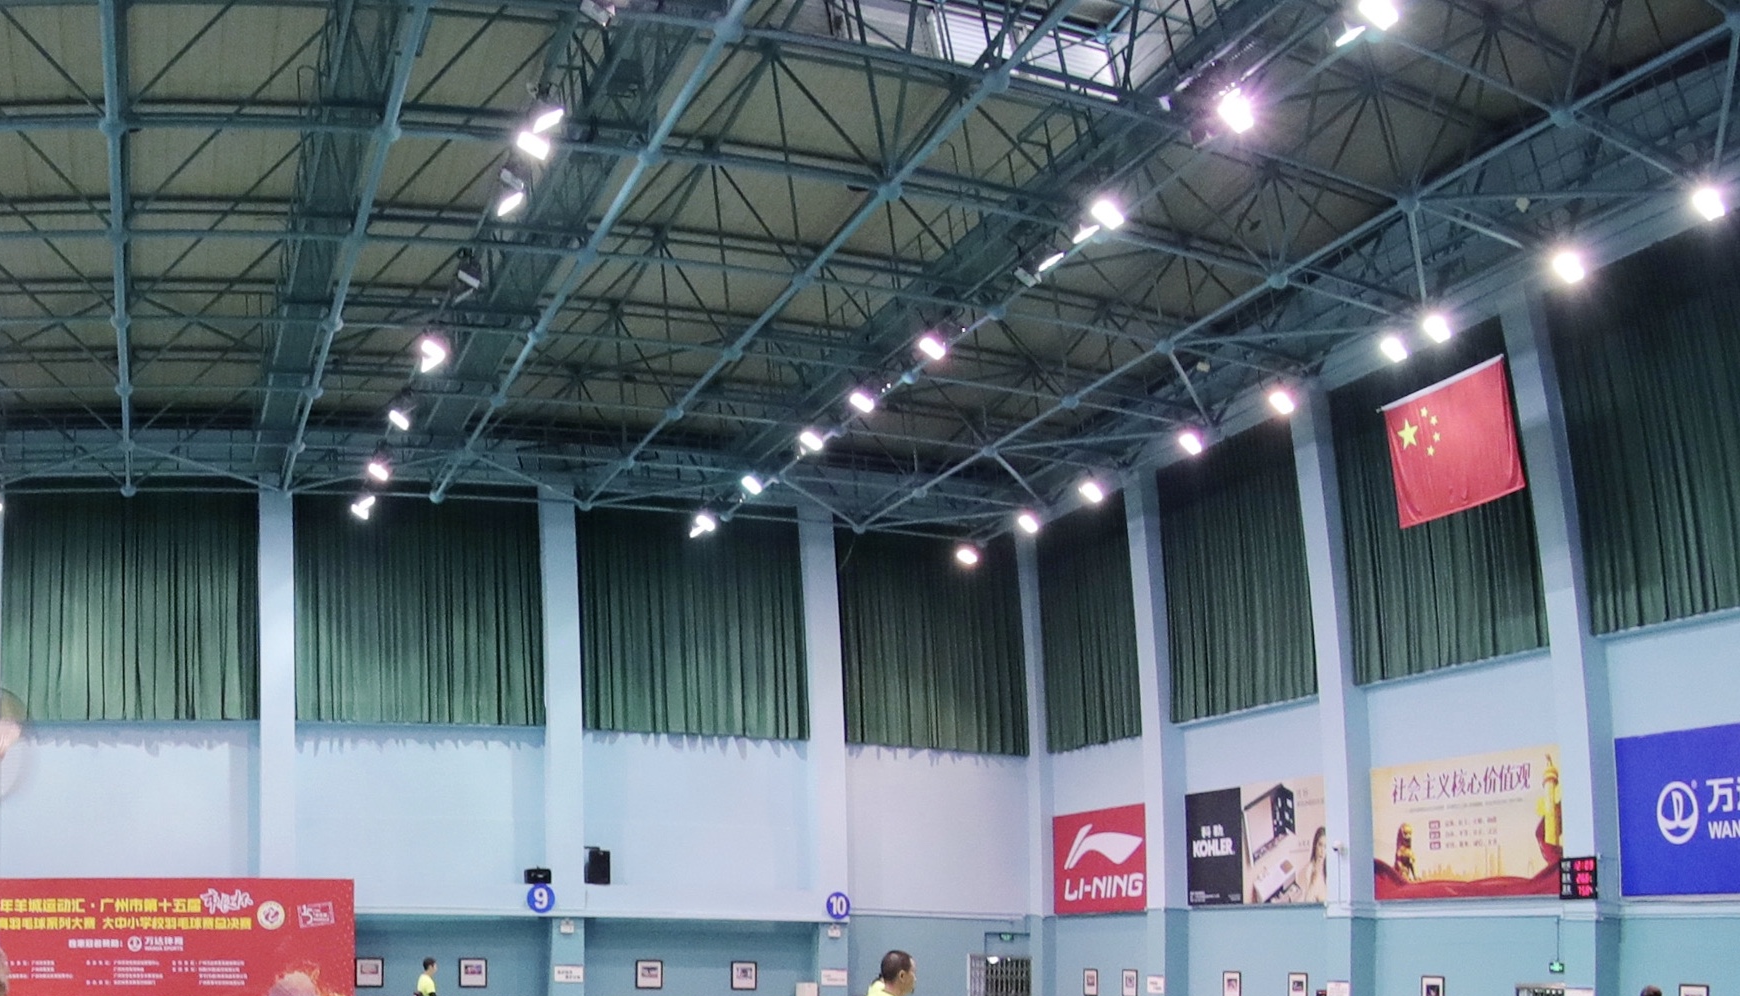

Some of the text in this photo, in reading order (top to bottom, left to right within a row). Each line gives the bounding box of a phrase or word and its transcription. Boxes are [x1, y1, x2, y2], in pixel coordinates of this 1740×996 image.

[1392, 762, 1531, 804] 社会主义核心价值观
[1192, 838, 1233, 858] KOHLER
[1064, 872, 1144, 901] LI-NING
[533, 887, 549, 910] 9
[829, 895, 846, 916] 10
[144, 936, 184, 946] 万达体育
